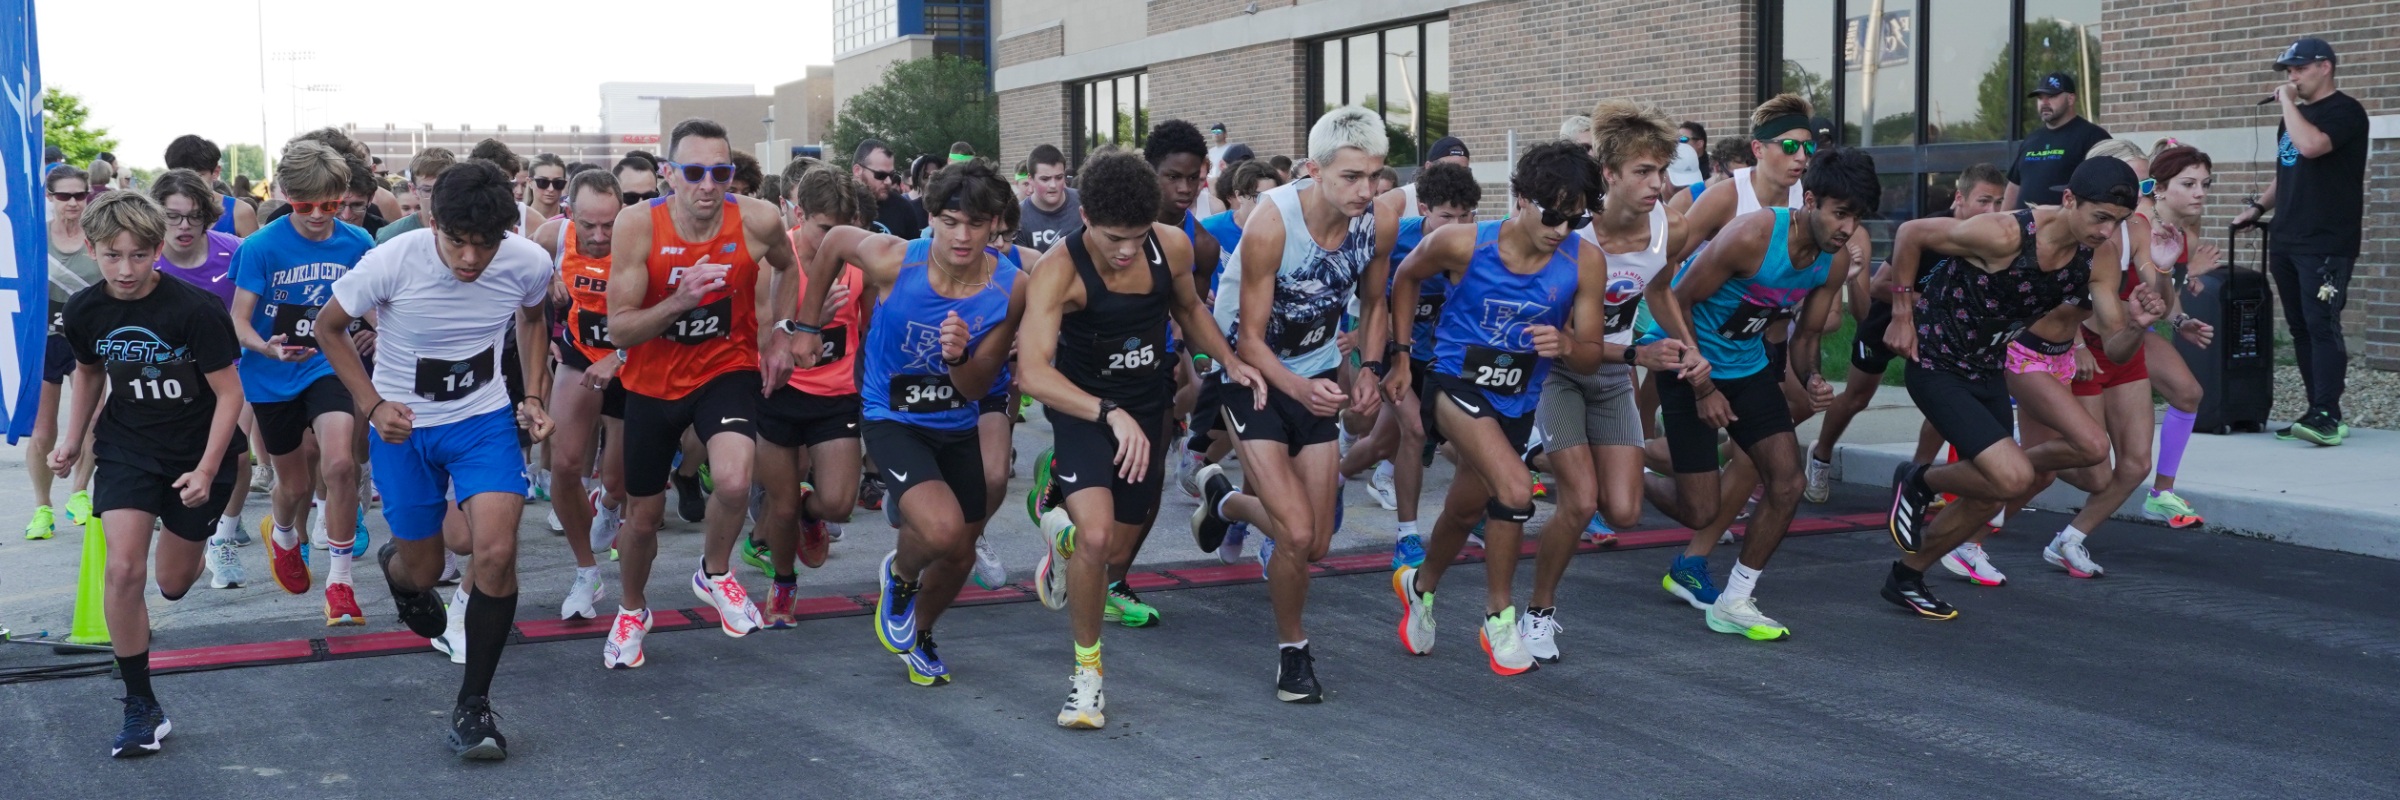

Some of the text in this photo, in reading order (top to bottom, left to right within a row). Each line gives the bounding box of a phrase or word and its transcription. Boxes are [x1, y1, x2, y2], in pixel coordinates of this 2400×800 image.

[271, 262, 320, 288] FRANKLIN
[573, 274, 608, 293] PB
[675, 315, 719, 337] 122
[1299, 325, 1326, 346] 48
[1741, 317, 1768, 333] 70
[1108, 344, 1154, 369] 265
[442, 370, 475, 392] 14
[1475, 365, 1523, 387] 250
[128, 378, 182, 399] 110
[905, 385, 953, 403] 340
